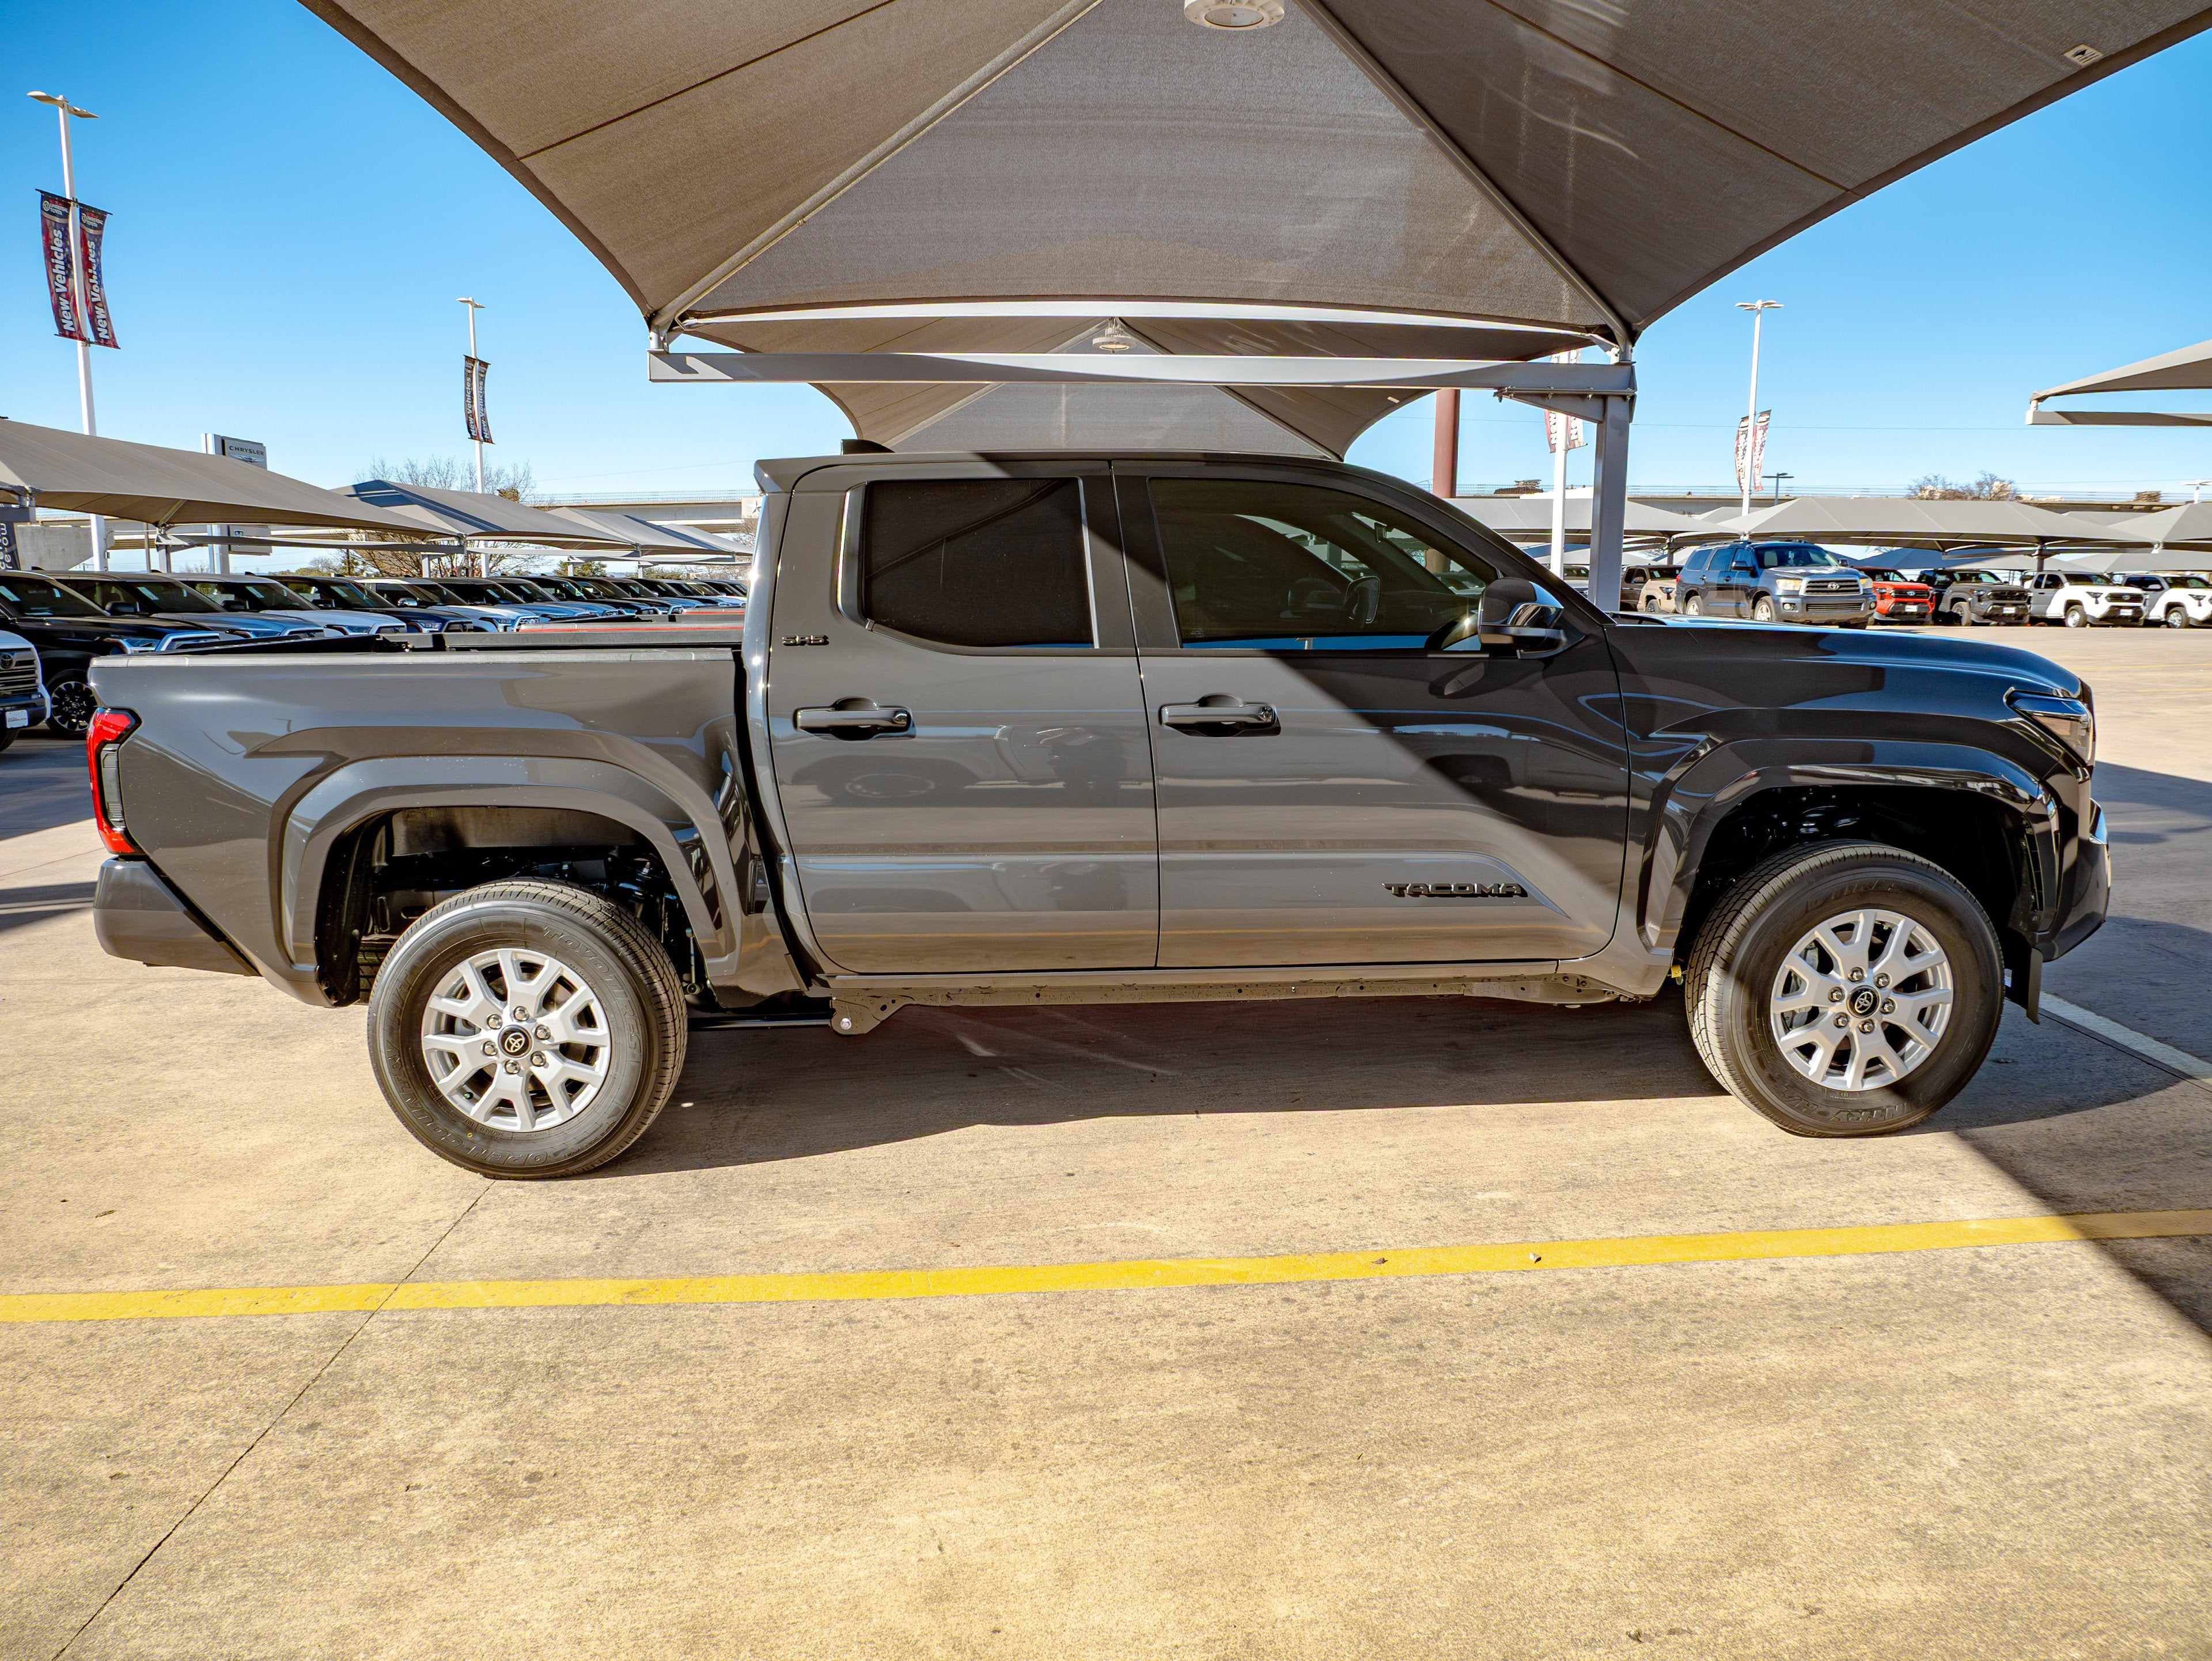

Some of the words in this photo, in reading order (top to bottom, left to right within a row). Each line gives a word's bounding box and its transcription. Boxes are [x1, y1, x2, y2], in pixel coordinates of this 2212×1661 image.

[50, 229, 67, 293] Vehicles
[59, 297, 75, 332] New
[94, 307, 109, 339] New
[229, 445, 264, 456] CHRYSLER
[1382, 883, 1528, 898] TACOMA
